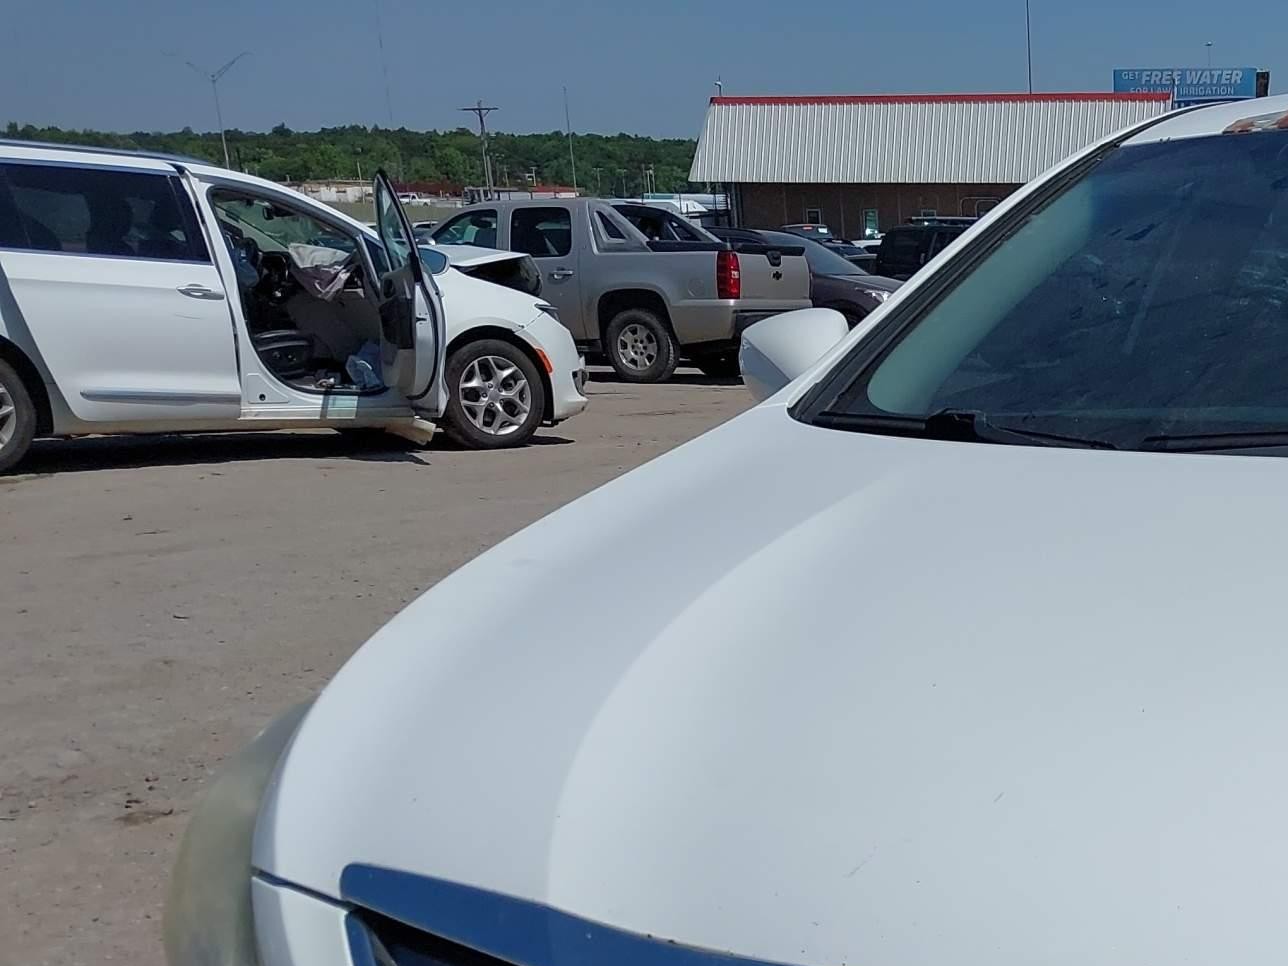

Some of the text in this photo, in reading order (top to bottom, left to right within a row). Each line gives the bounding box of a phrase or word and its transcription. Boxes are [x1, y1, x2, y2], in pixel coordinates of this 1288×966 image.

[1121, 70, 1243, 85] GET FREE WATER
[1180, 86, 1235, 96] IRRIGATION
